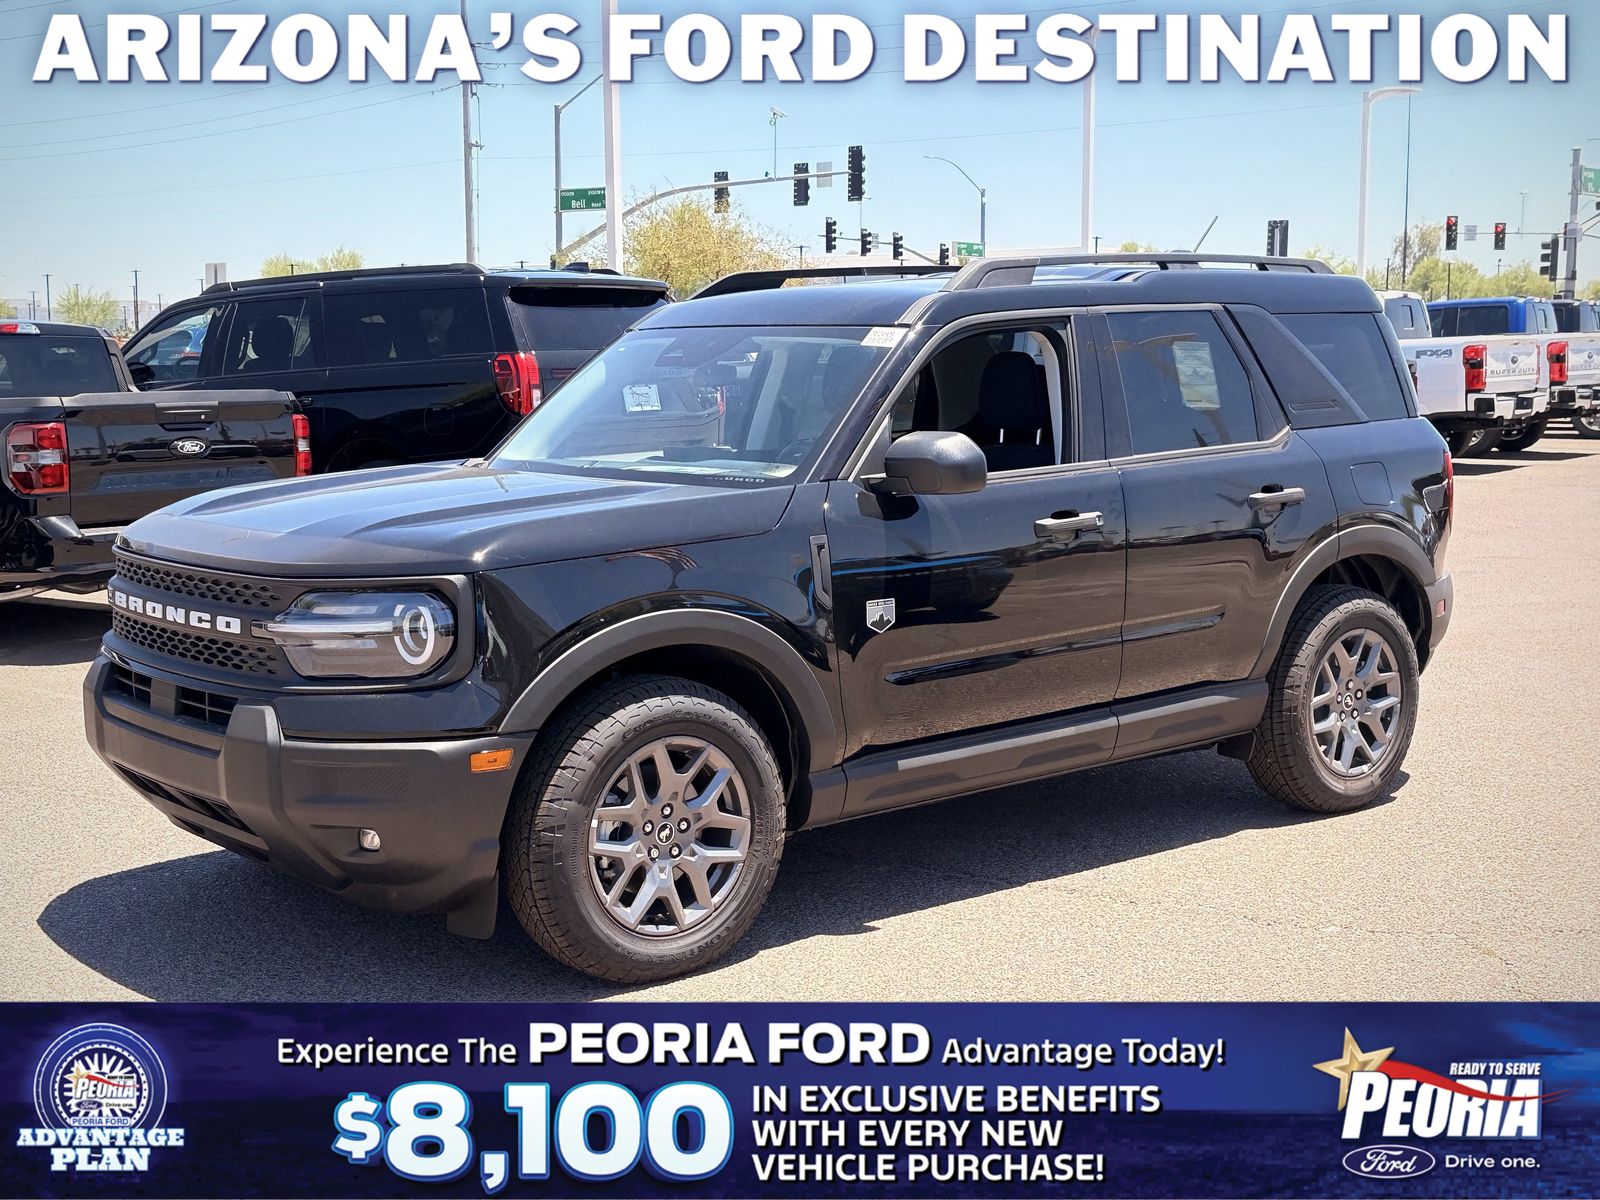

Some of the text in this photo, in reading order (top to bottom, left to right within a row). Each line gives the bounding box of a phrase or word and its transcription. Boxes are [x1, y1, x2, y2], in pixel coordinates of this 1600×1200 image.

[571, 199, 586, 208] Bell
[1415, 349, 1453, 359] FX4
[114, 590, 241, 634] BRONCO
